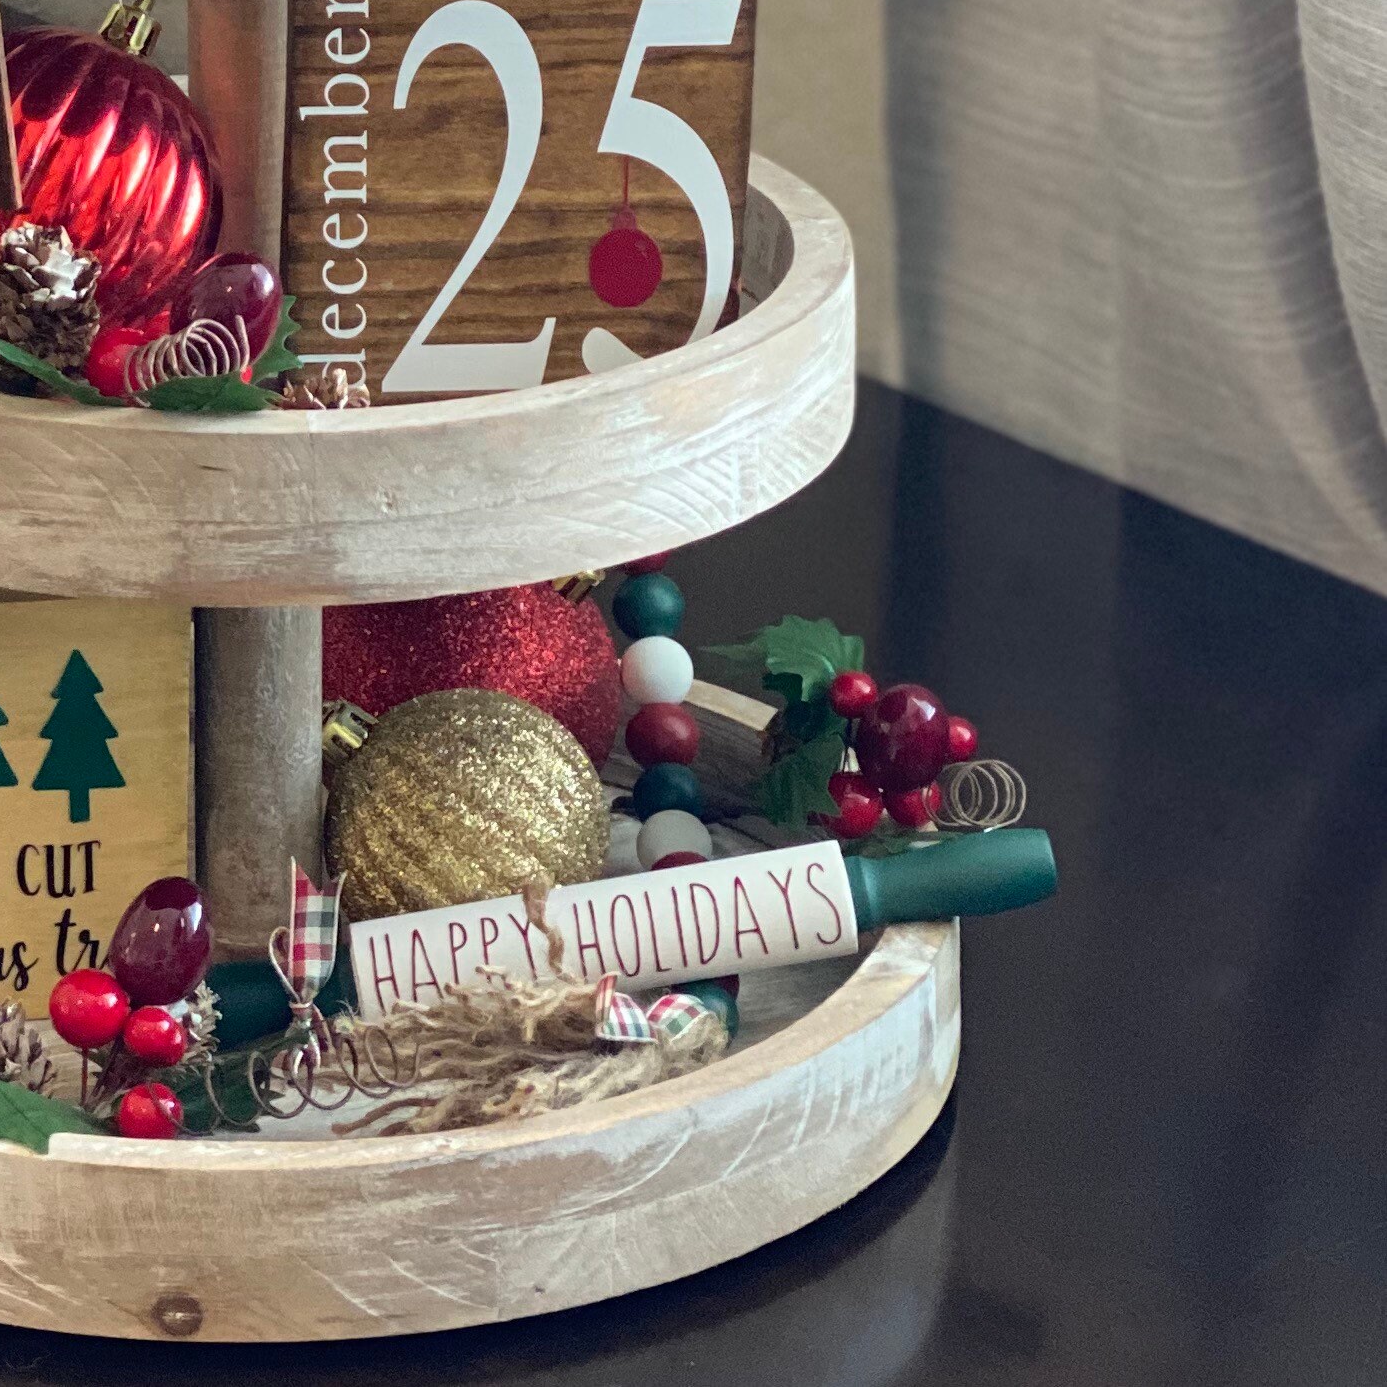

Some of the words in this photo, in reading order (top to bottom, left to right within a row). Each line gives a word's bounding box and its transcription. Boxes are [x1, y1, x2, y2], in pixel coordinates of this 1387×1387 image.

[16, 839, 101, 898] CUT
[369, 912, 538, 1015] HAPPY
[572, 862, 843, 978] HOLIDAYS
